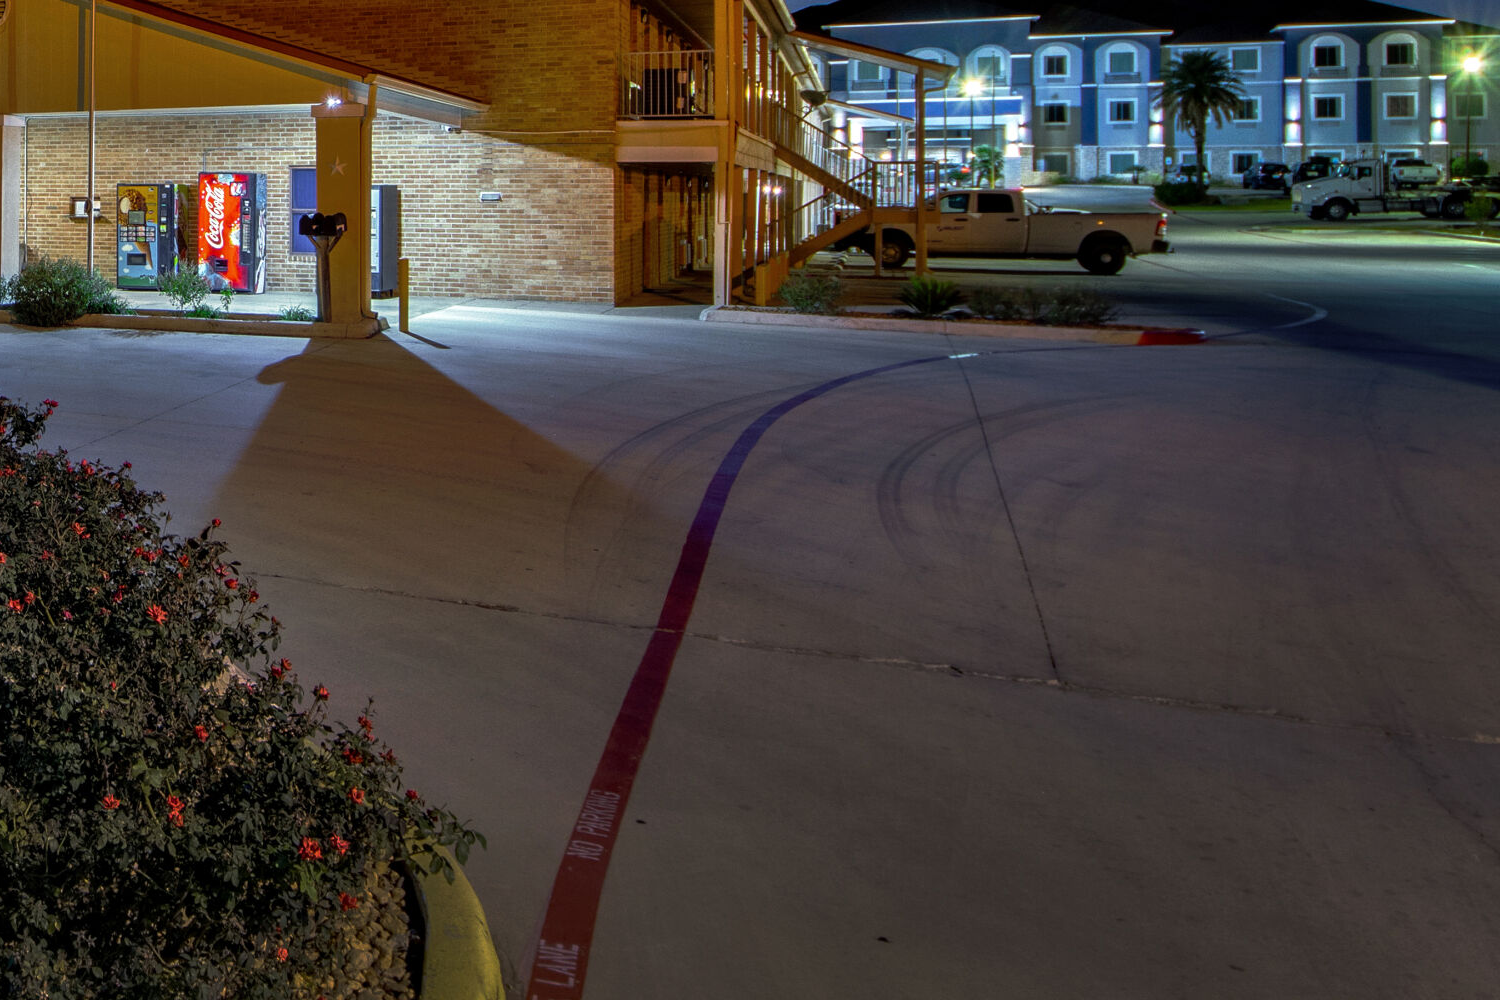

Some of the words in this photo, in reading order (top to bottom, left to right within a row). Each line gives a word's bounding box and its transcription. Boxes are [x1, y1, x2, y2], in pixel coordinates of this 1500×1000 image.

[577, 790, 621, 838] PARKING
[566, 840, 604, 861] NO
[535, 939, 580, 989] LANE
